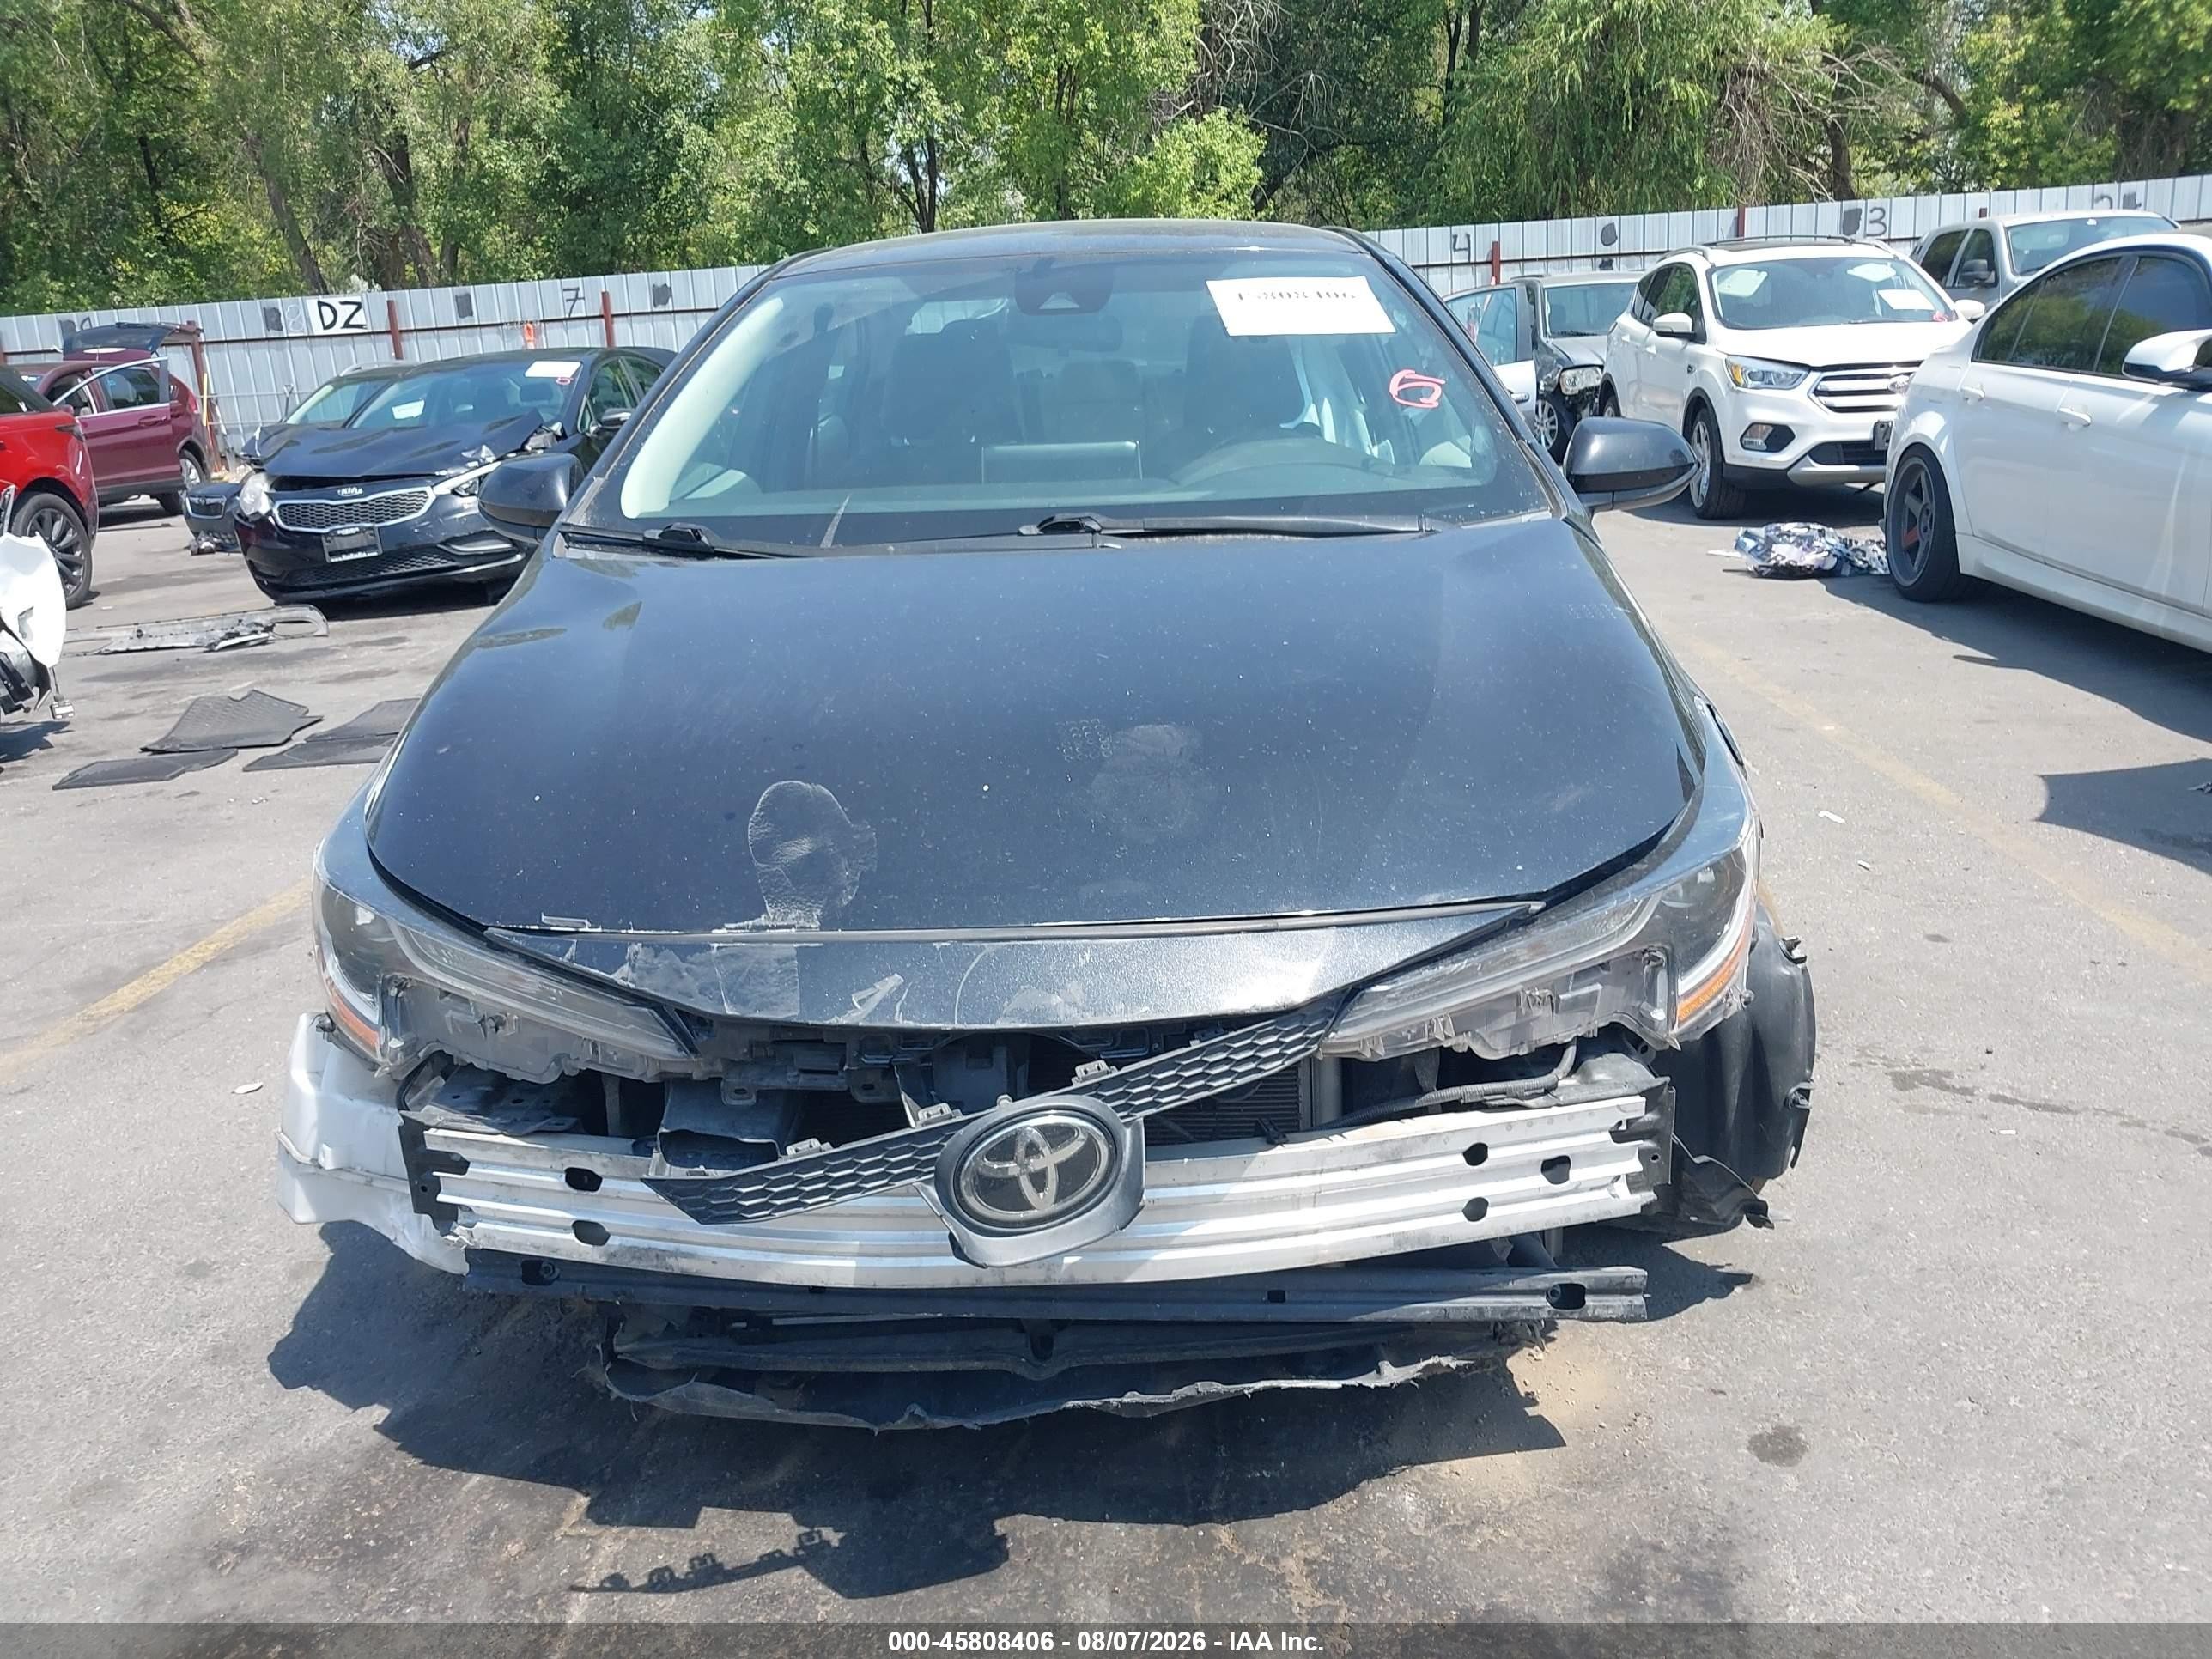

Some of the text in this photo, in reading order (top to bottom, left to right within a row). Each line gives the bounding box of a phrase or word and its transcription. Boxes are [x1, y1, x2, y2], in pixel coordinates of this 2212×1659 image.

[1866, 207, 1887, 237] 3
[1452, 233, 1471, 264] 4
[317, 300, 368, 331] DZ
[562, 287, 586, 318] 7
